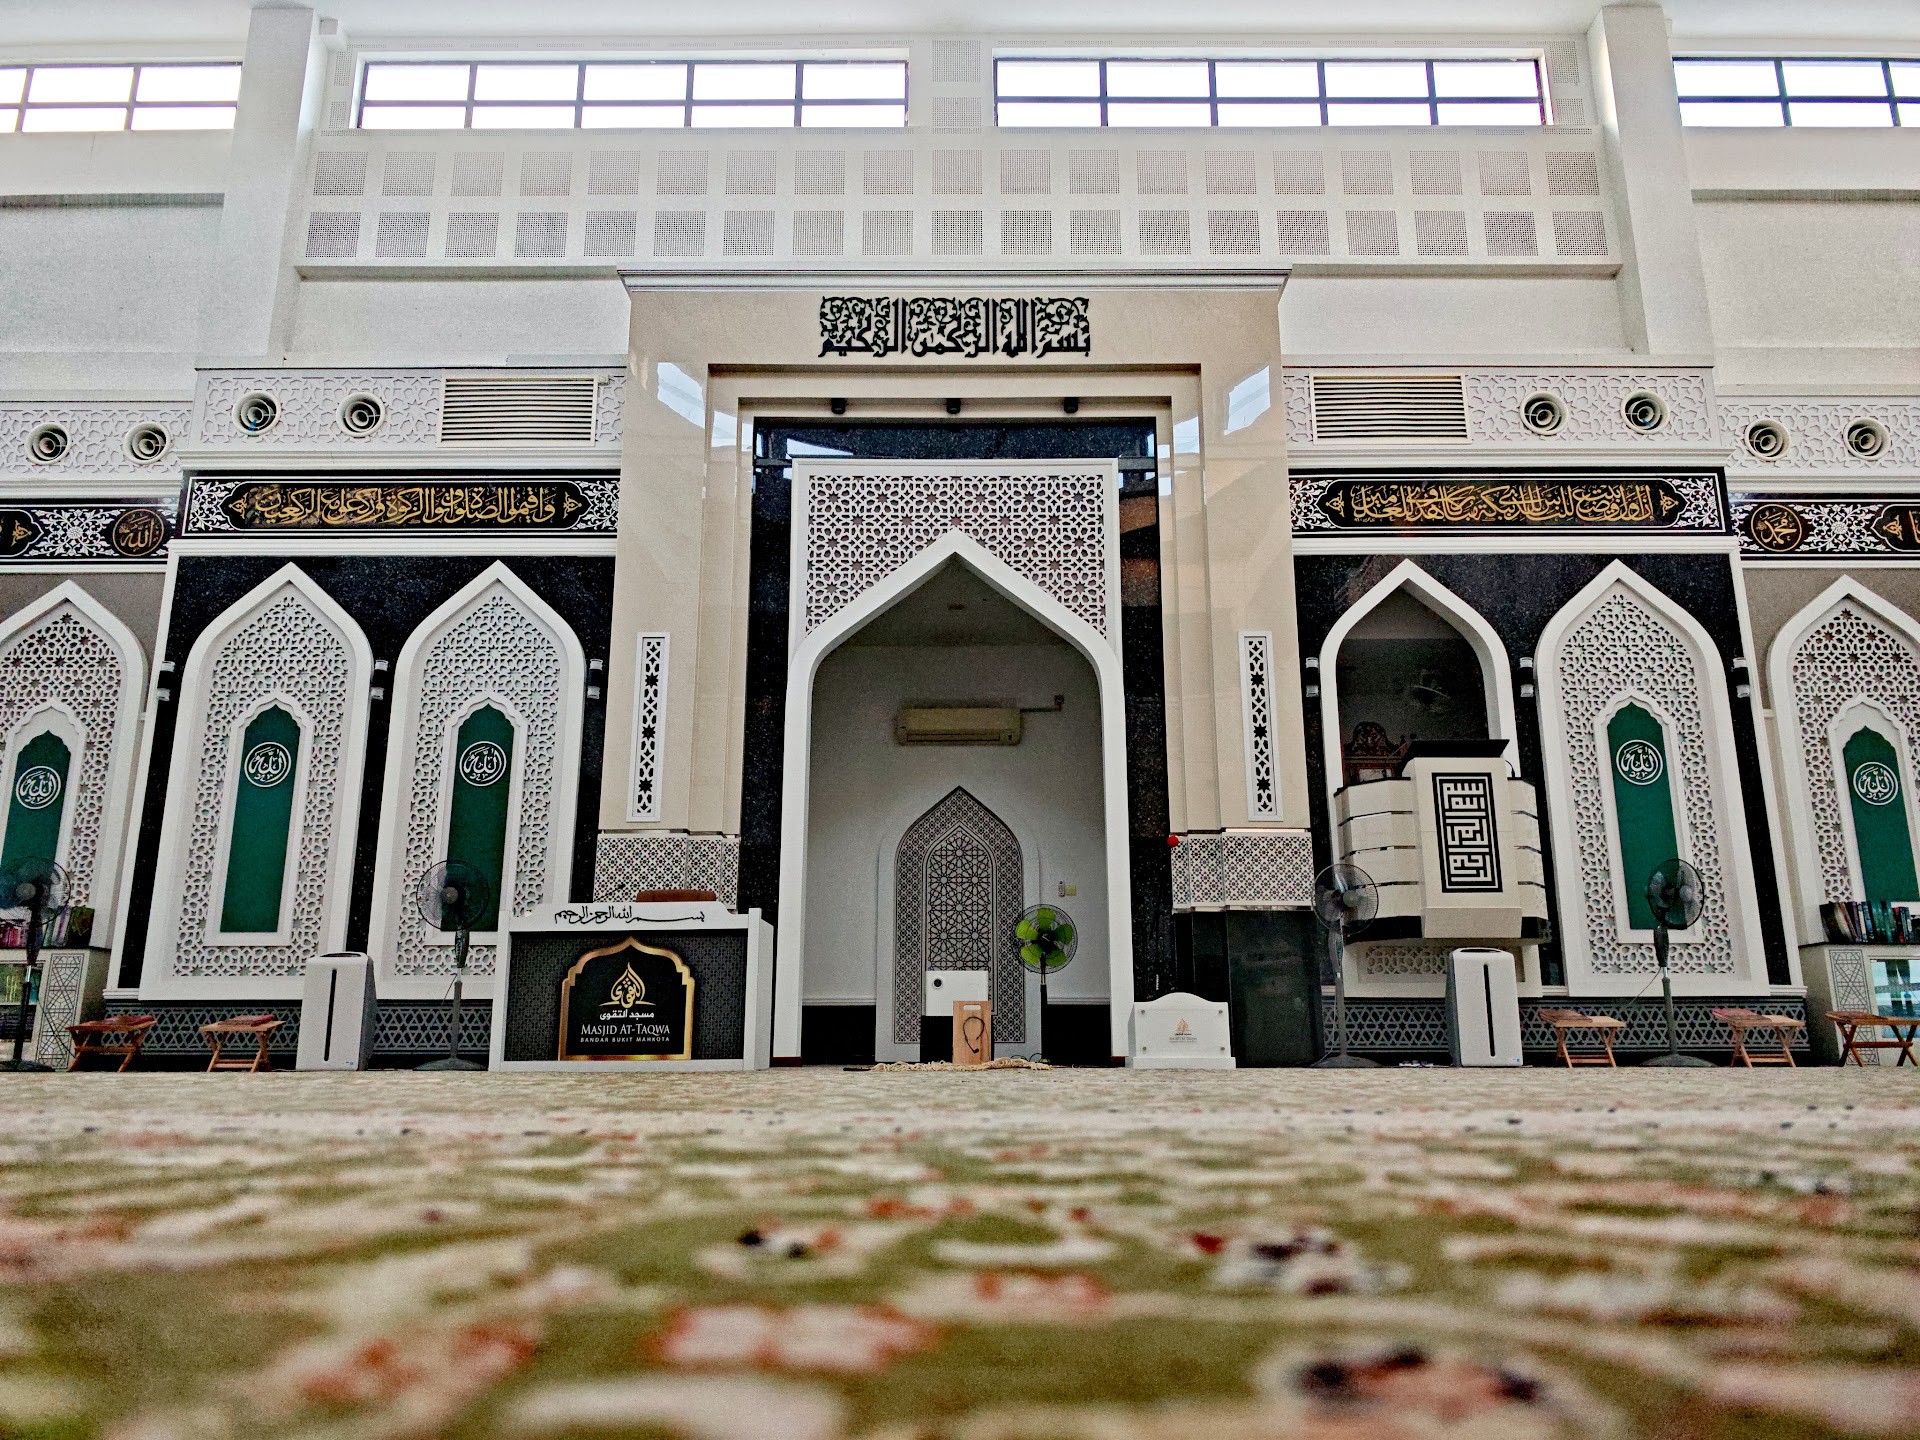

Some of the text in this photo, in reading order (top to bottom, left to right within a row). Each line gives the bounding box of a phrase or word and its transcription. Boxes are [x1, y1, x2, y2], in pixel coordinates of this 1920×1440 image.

[599, 1008, 655, 1020] مسجد التقوى
[619, 1023, 670, 1036] AT-TAQWA
